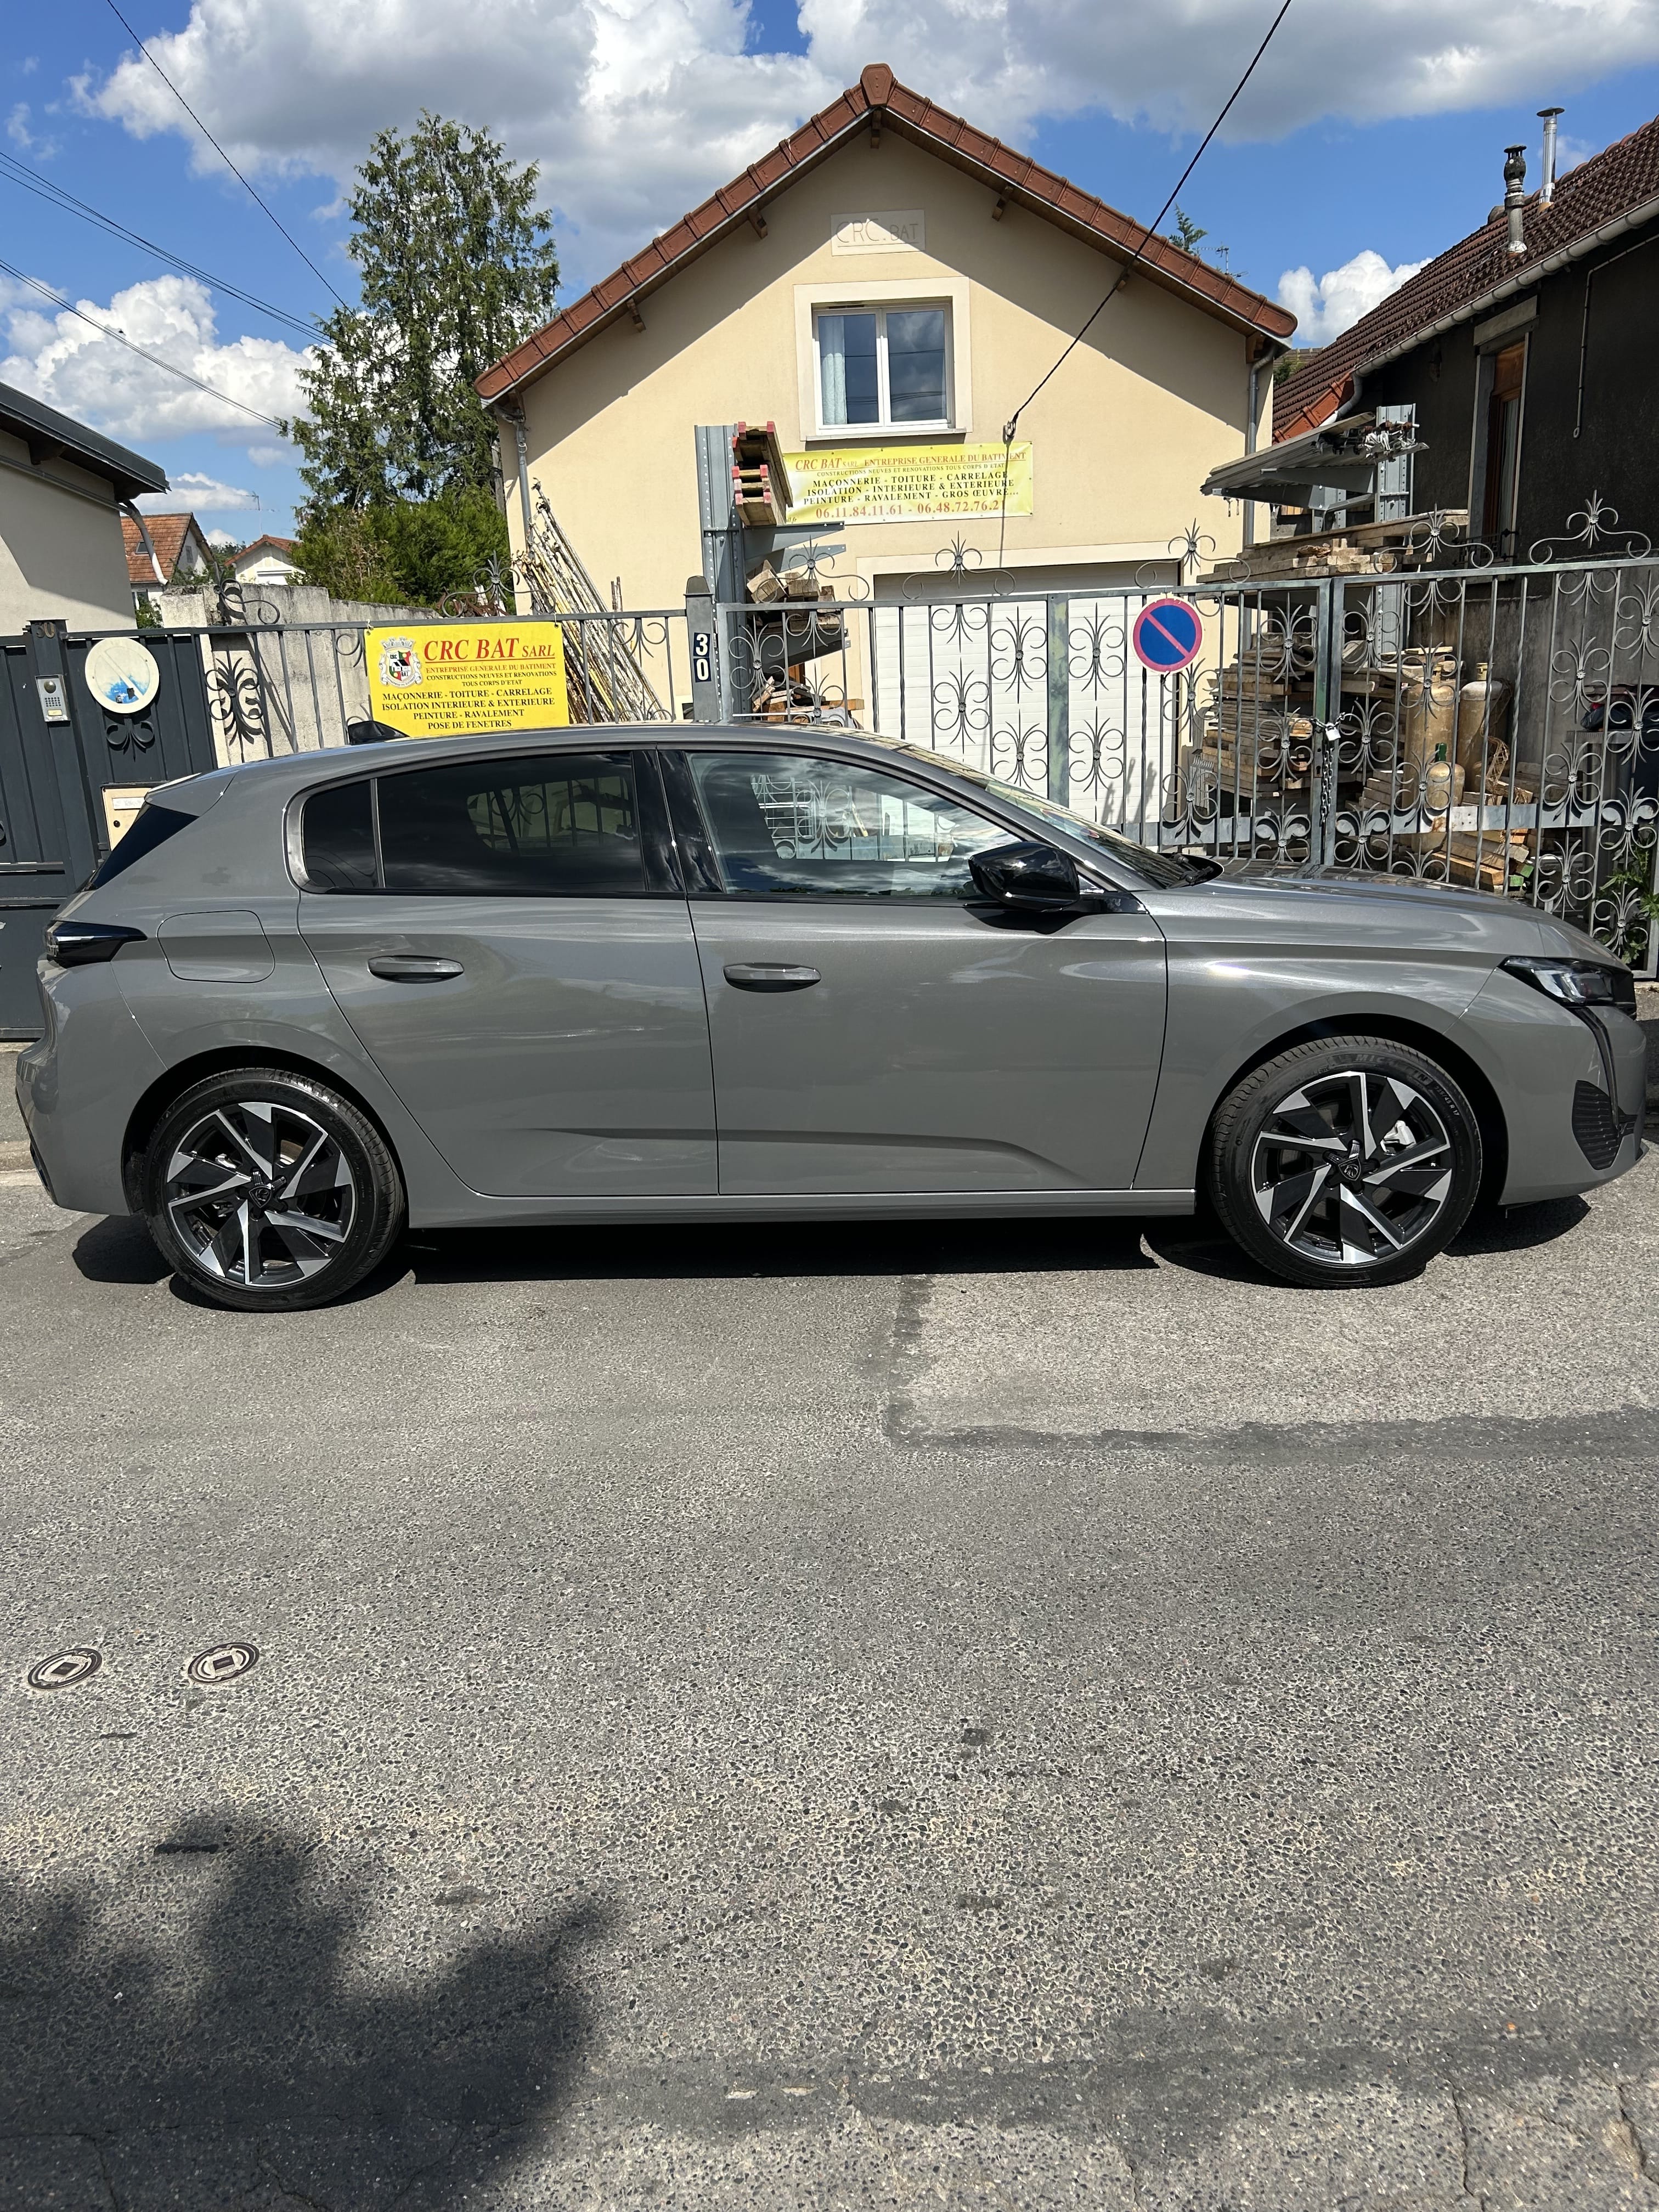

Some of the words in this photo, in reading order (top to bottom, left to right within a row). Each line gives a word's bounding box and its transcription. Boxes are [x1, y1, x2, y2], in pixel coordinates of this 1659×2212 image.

[795, 459, 818, 470] CRC
[821, 458, 842, 469] BAT
[865, 457, 917, 466] ENTREPRISE
[919, 454, 966, 464] GENERALE
[813, 477, 881, 488] MAÇONNERIE
[891, 475, 936, 483] TOITURE
[947, 471, 1008, 481] CARRELAGE
[808, 487, 862, 496] ISOLATION
[873, 483, 935, 492] INTERIEURE
[950, 479, 1014, 489] EXTERIEURE
[804, 496, 854, 505] PEINTURE
[865, 492, 932, 502] RAVALEMENT
[943, 490, 969, 498] GROS
[816, 504, 902, 518] 06.11.84.11.61
[424, 640, 469, 661] CRC
[476, 638, 520, 659] BAT
[522, 645, 555, 657] SARL
[696, 634, 709, 681] 30
[382, 691, 443, 702] MAÇONNERIE
[449, 690, 489, 698] TOITURE
[496, 687, 552, 697] CARRELAGE
[382, 702, 429, 711] ISOLATION
[432, 701, 486, 709] INTERIEURE
[498, 698, 555, 707] EXTERIEURE
[413, 712, 458, 720] PEINTURE
[465, 709, 524, 718] RAVALEMENT
[466, 720, 512, 729] FENETRES
